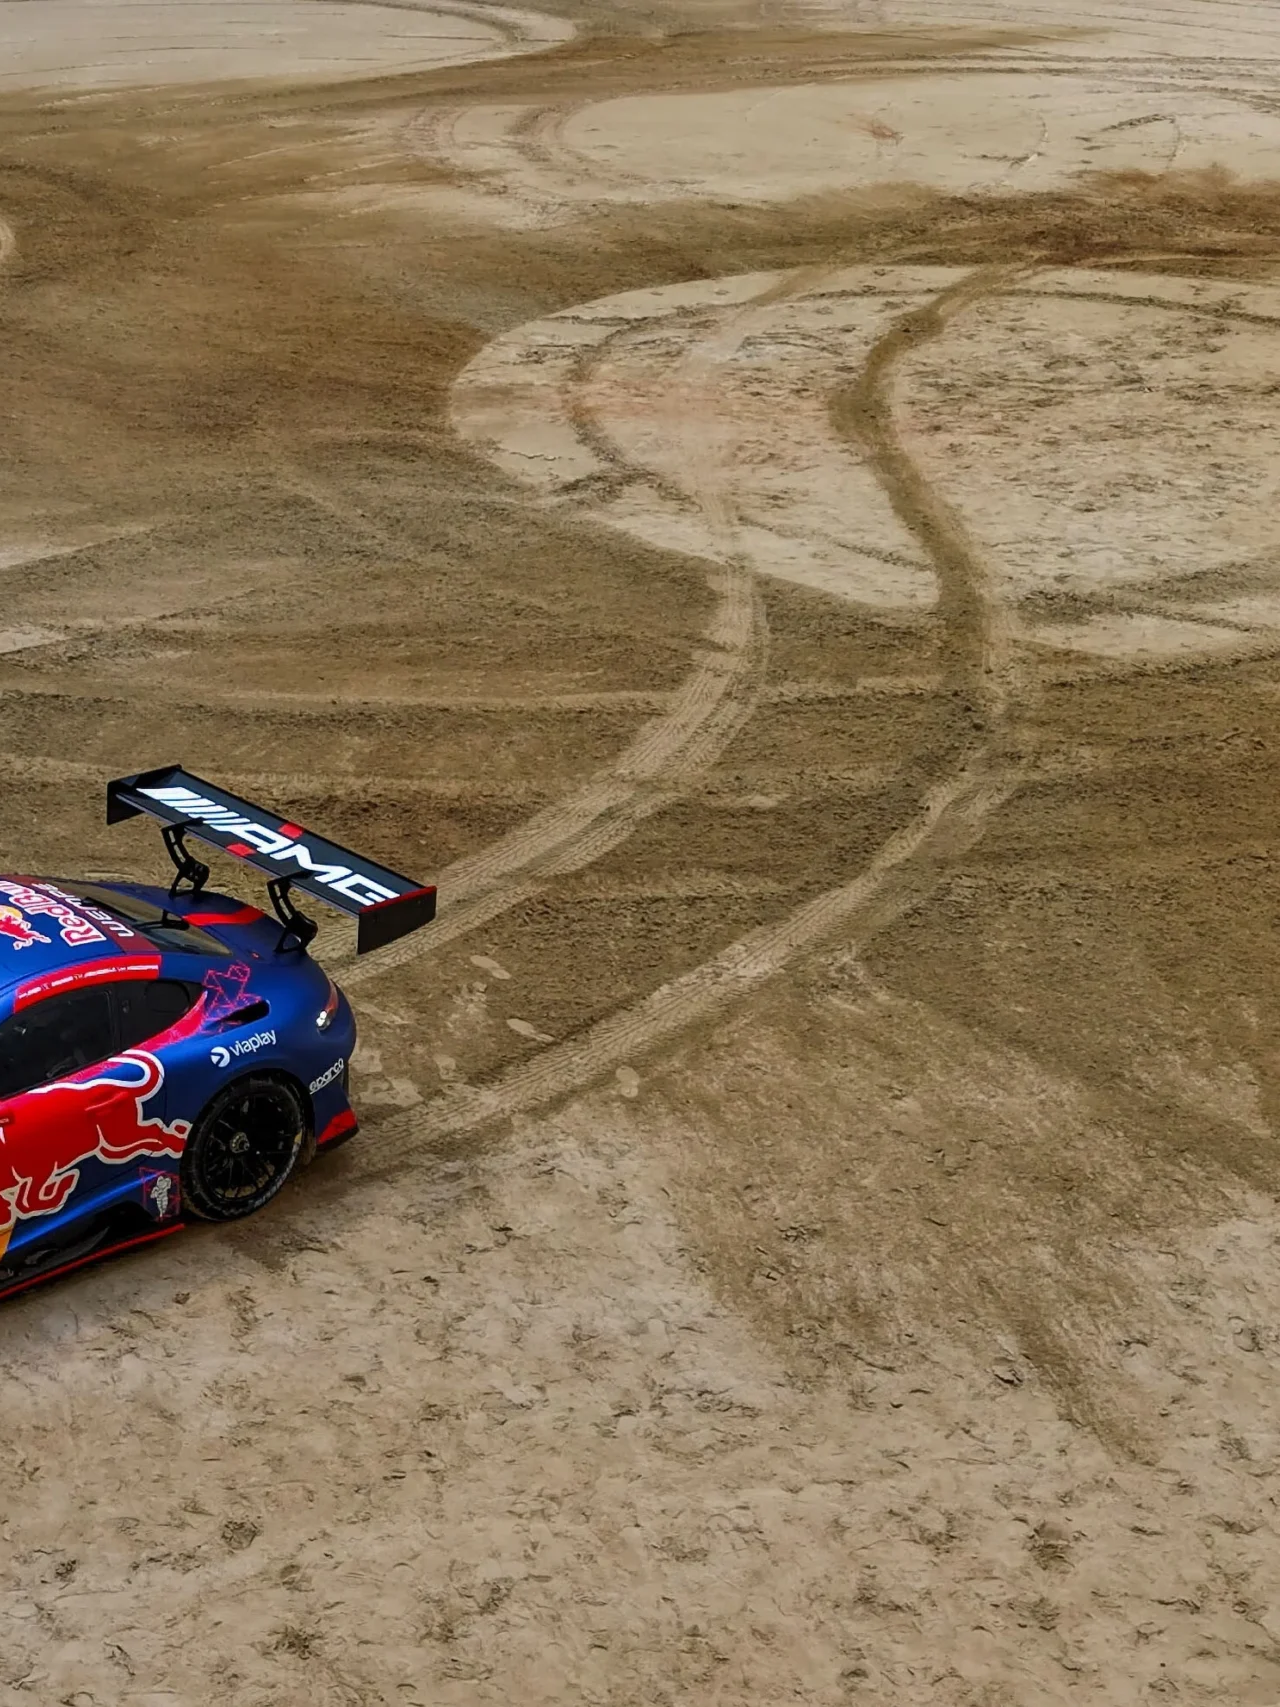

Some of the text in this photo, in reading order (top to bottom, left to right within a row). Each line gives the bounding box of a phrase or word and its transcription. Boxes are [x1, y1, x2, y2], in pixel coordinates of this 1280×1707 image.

[211, 822, 401, 906] AMG
[24, 903, 106, 946] Red
[229, 1030, 277, 1057] viaplay
